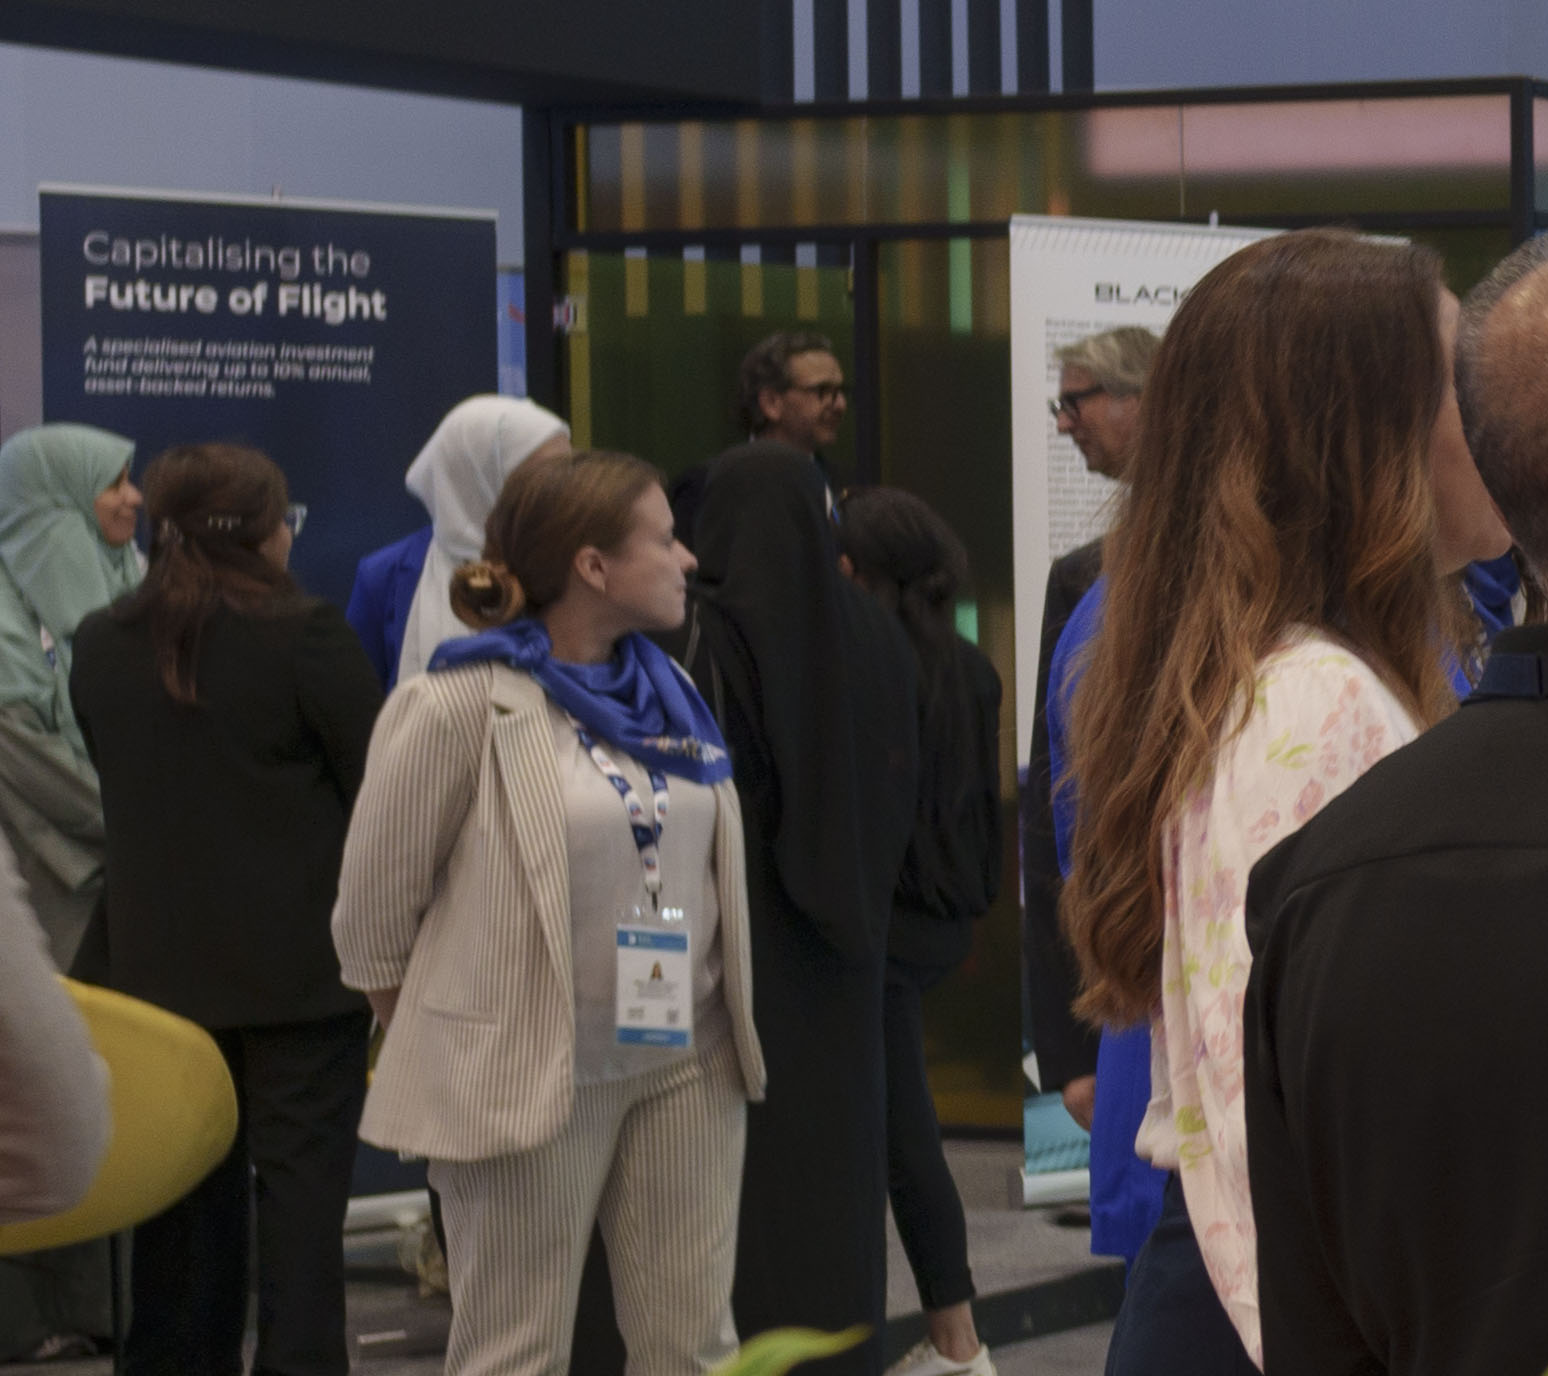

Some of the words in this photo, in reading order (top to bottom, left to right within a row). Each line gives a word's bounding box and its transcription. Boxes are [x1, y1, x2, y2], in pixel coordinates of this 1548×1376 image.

[83, 230, 302, 280] Capitalising
[311, 242, 371, 277] the
[84, 274, 218, 313] Future
[228, 282, 268, 315] of
[279, 283, 387, 325] Flight
[84, 355, 127, 374] fund
[205, 339, 276, 359] aviation
[280, 342, 374, 364] investment
